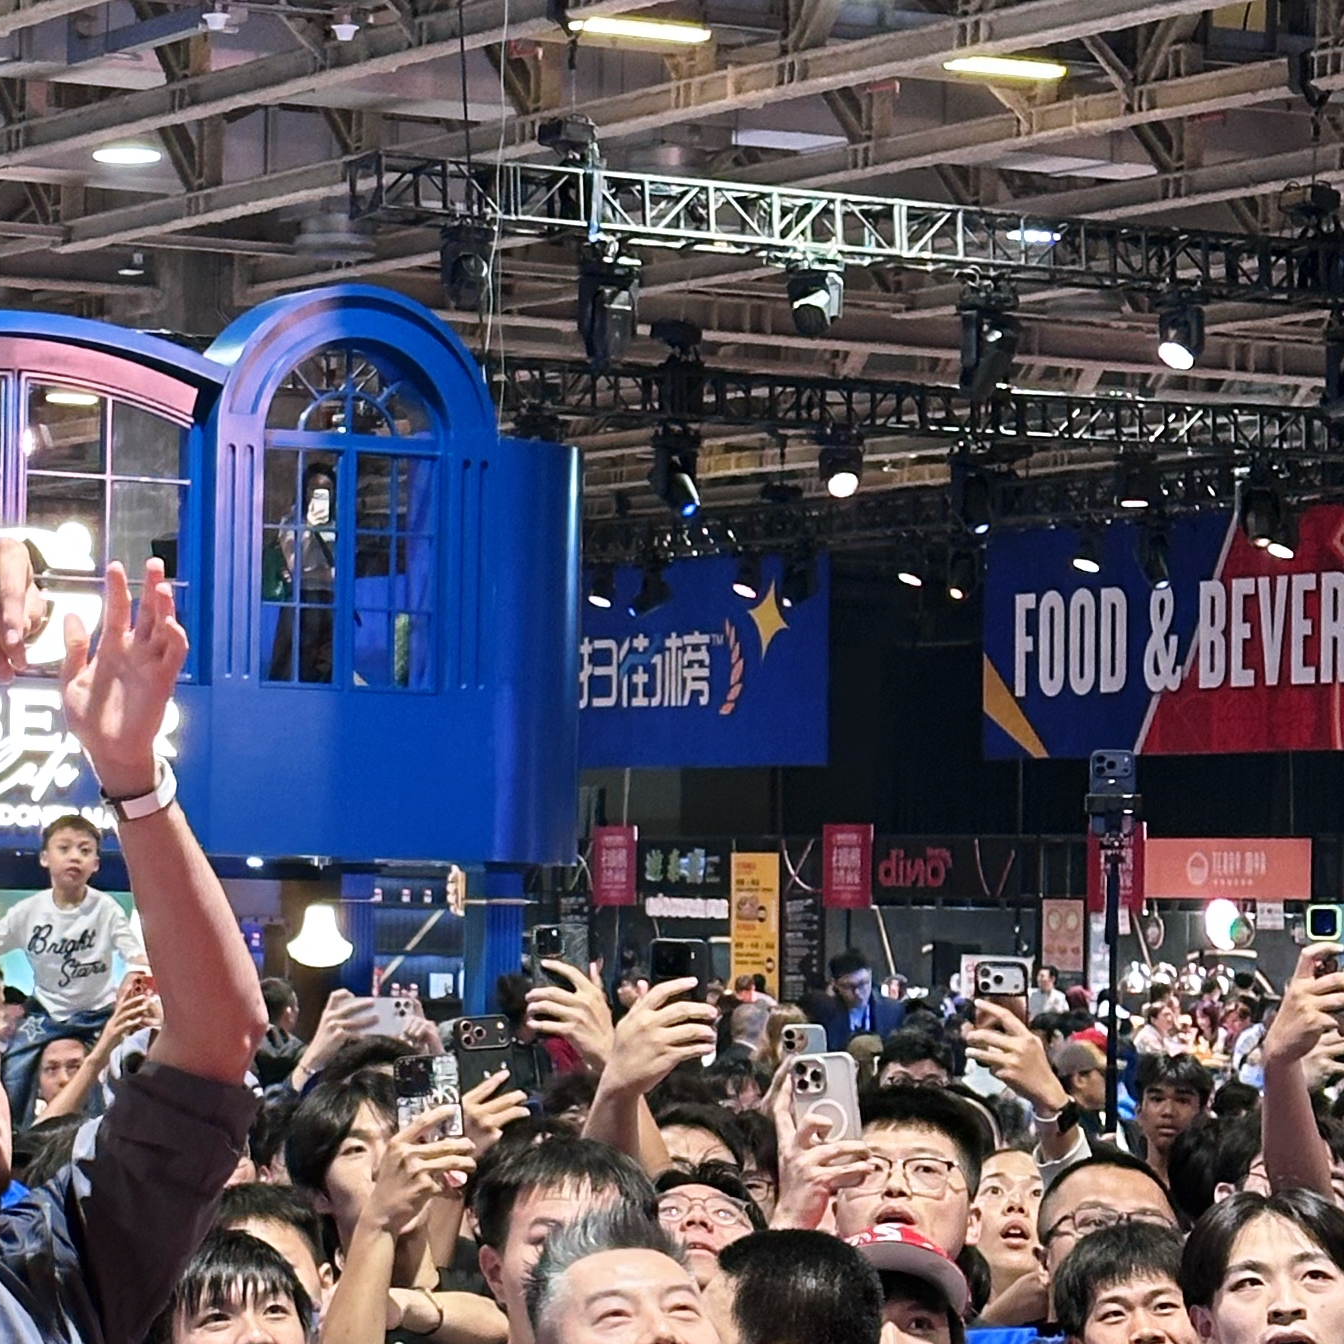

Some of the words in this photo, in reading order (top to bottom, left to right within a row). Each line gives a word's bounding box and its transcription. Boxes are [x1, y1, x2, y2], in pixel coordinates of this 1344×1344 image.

[579, 631, 710, 709] 扫街榜
[1014, 587, 1128, 697] FOOD
[1143, 585, 1183, 693] &
[28, 924, 96, 959] Bright
